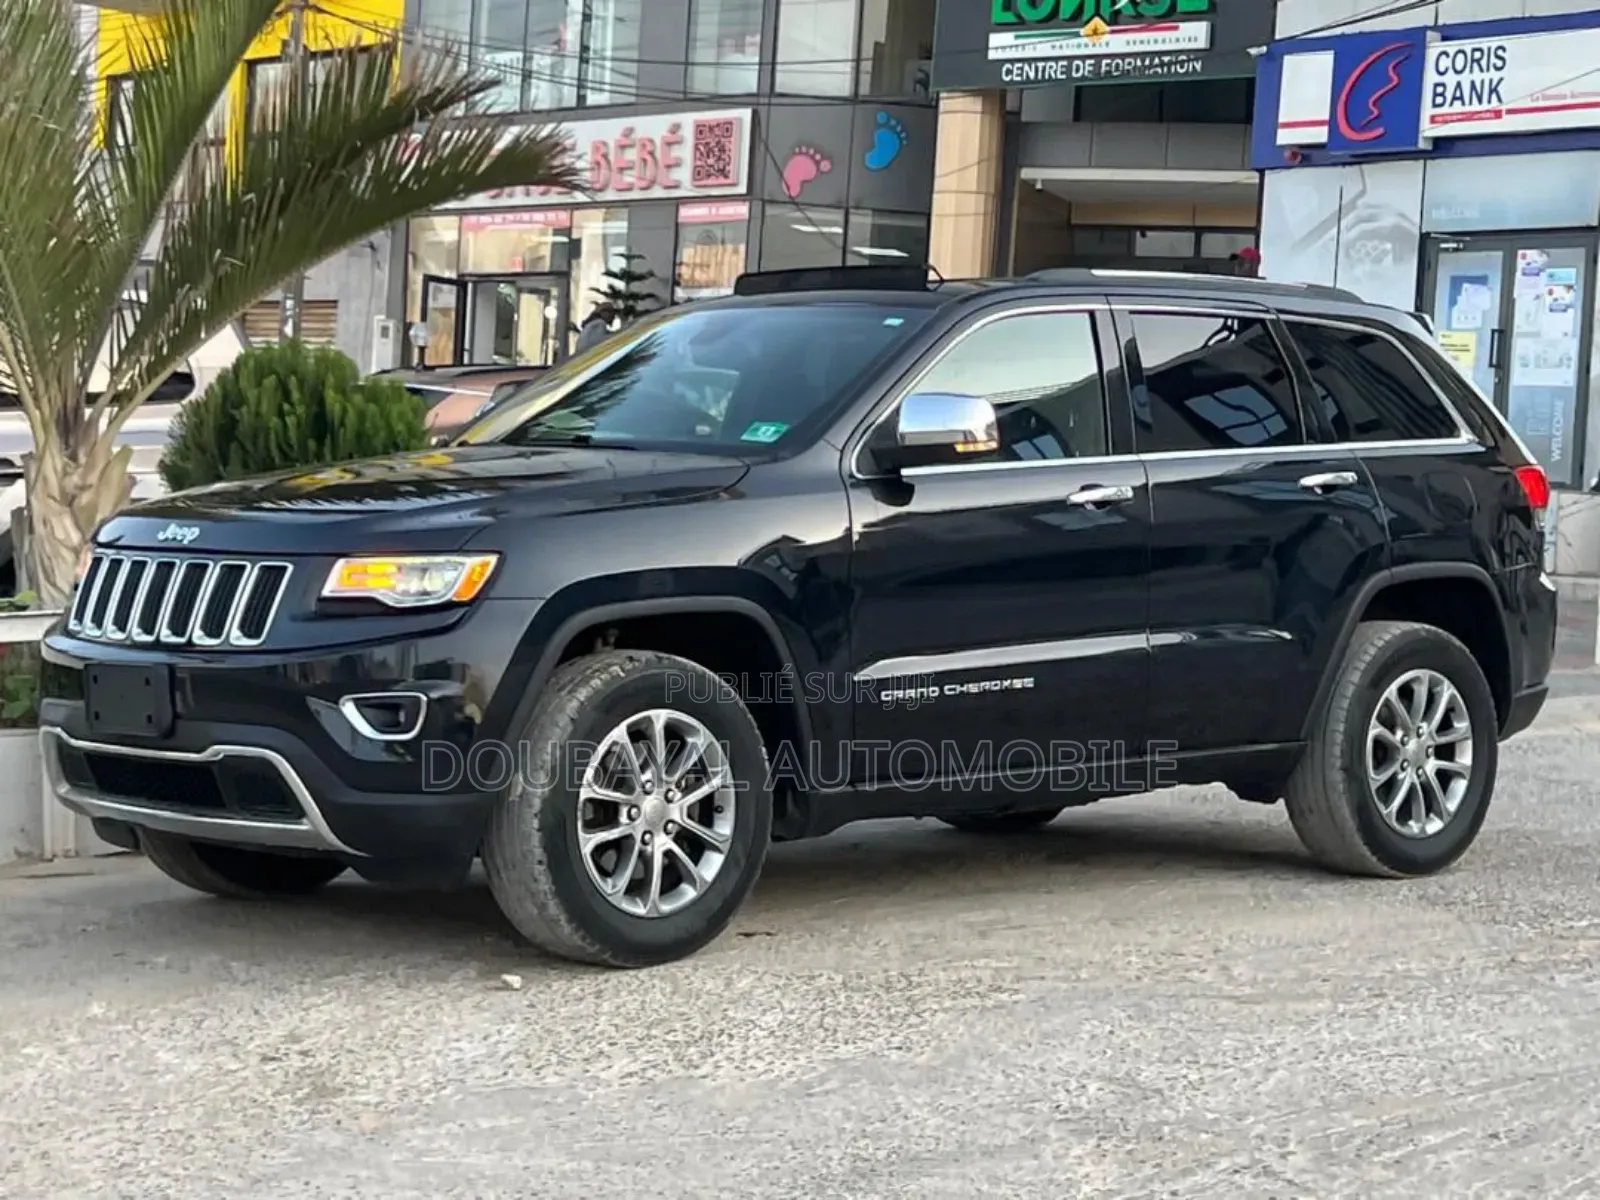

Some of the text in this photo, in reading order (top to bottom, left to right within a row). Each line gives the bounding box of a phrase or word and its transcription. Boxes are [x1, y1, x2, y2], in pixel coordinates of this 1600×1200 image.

[1001, 55, 1202, 81] CENTRE DE FORMATION
[1435, 45, 1508, 76] CORIS
[1431, 77, 1505, 109] BANK
[588, 122, 683, 192] BÉBÉ
[157, 523, 200, 545] Jeep
[880, 677, 1035, 701] GRAND CHEROKEE
